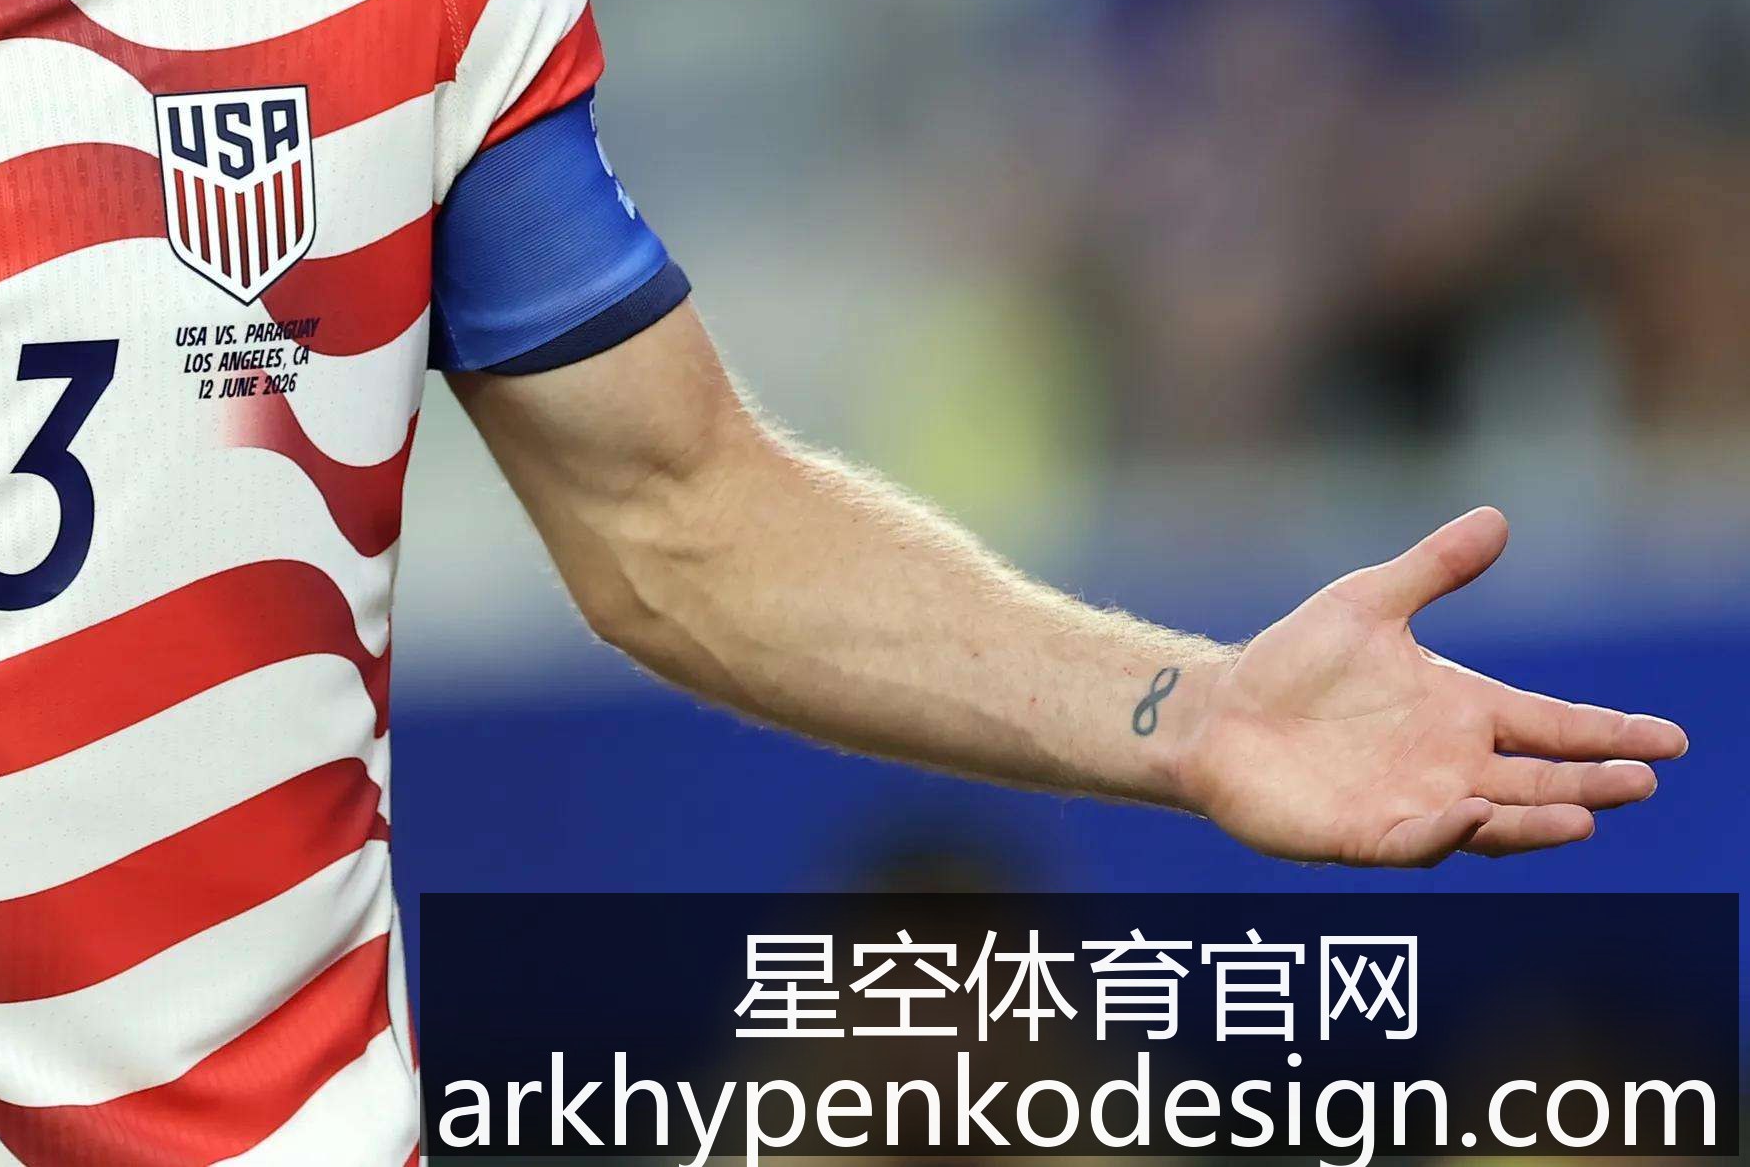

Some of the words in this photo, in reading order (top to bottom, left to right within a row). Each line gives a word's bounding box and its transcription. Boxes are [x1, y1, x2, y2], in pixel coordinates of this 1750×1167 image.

[167, 98, 299, 180] USA
[176, 326, 208, 347] USA
[215, 324, 238, 345] VS.
[244, 317, 322, 344] PARAGUAY
[184, 352, 213, 373] LOS
[218, 347, 287, 372] ANGELES,
[293, 345, 310, 366] CA
[198, 379, 214, 399] 12
[219, 376, 259, 399] JUNE
[262, 372, 298, 396] 2026
